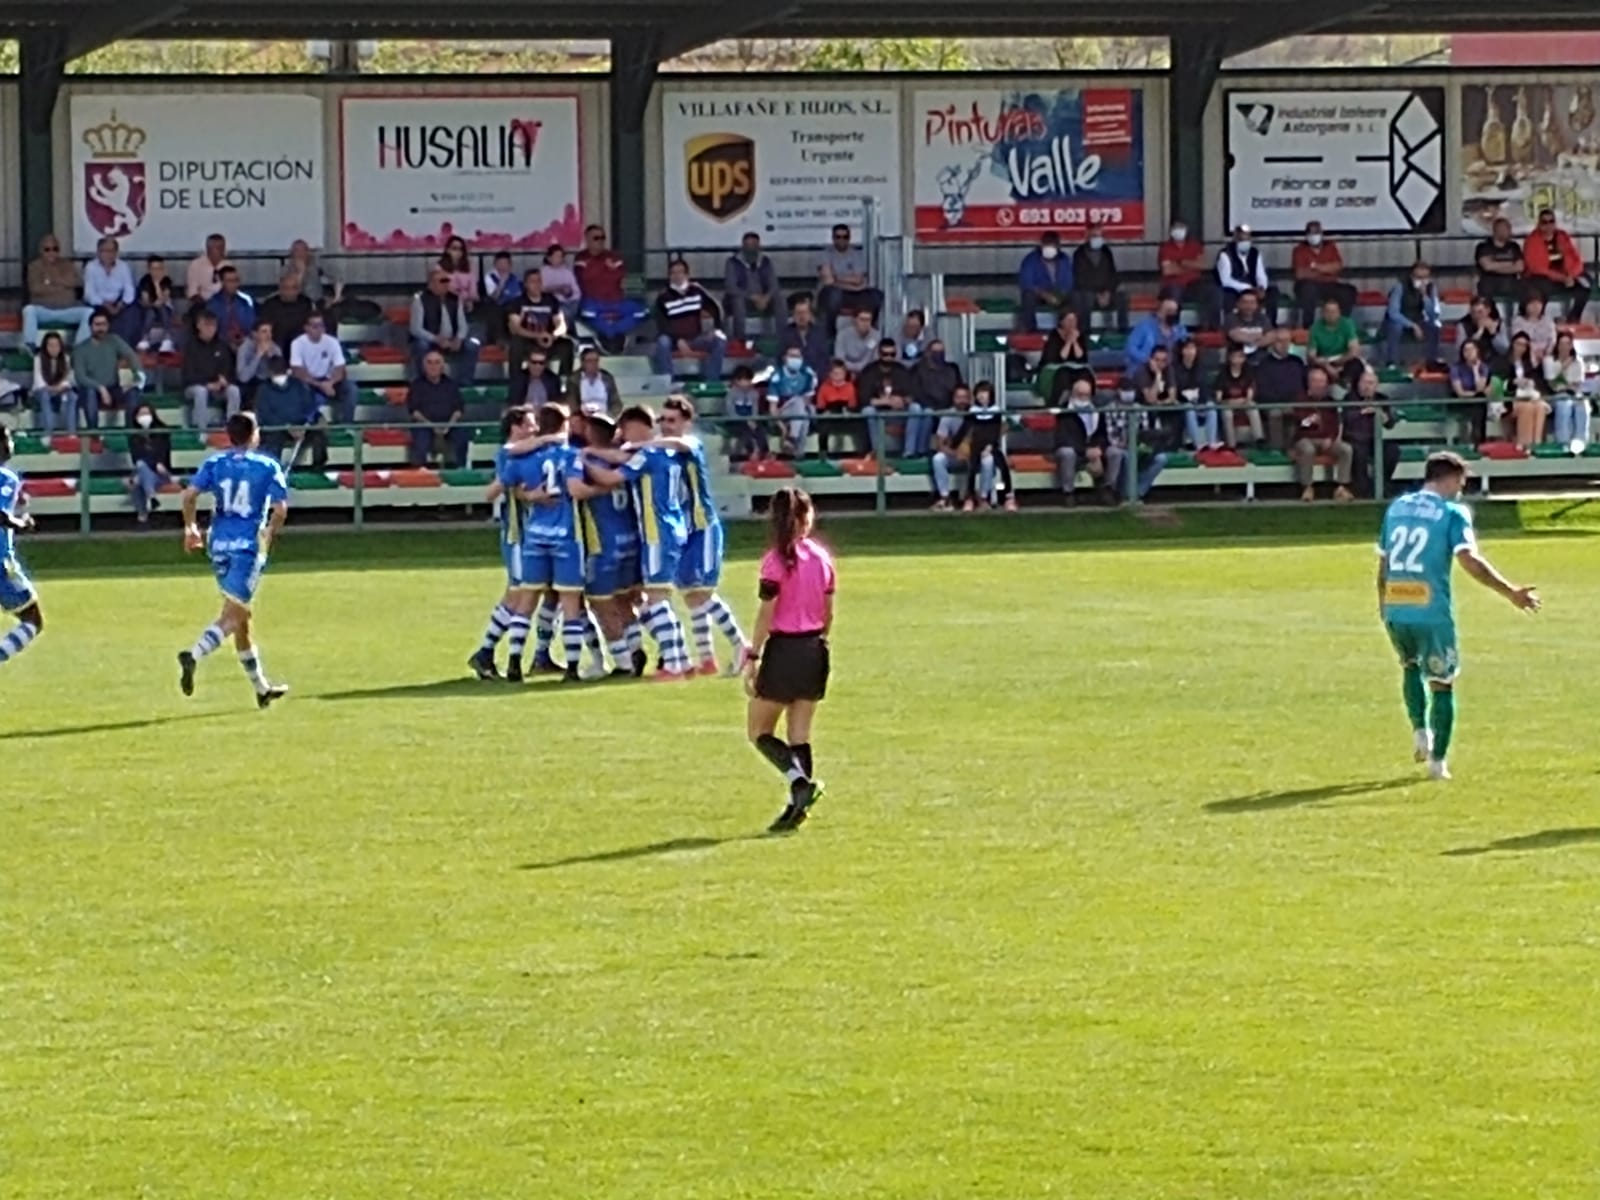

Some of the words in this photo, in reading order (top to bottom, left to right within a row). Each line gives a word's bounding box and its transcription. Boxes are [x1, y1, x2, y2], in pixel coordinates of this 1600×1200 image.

[679, 98, 779, 118] VILLAFAÑE
[785, 101, 796, 116] E
[925, 99, 1047, 147] Pinturas
[377, 123, 533, 170] HUSALIA
[790, 129, 865, 146] Transporte
[800, 149, 855, 165] Urgente
[158, 154, 314, 183] DIPUTACIÓN
[689, 159, 751, 210] ups
[1008, 135, 1101, 197] Valle
[158, 188, 191, 210] DE
[199, 183, 266, 210] LEÓN
[219, 477, 253, 519] 14
[1388, 525, 1429, 574] 22
